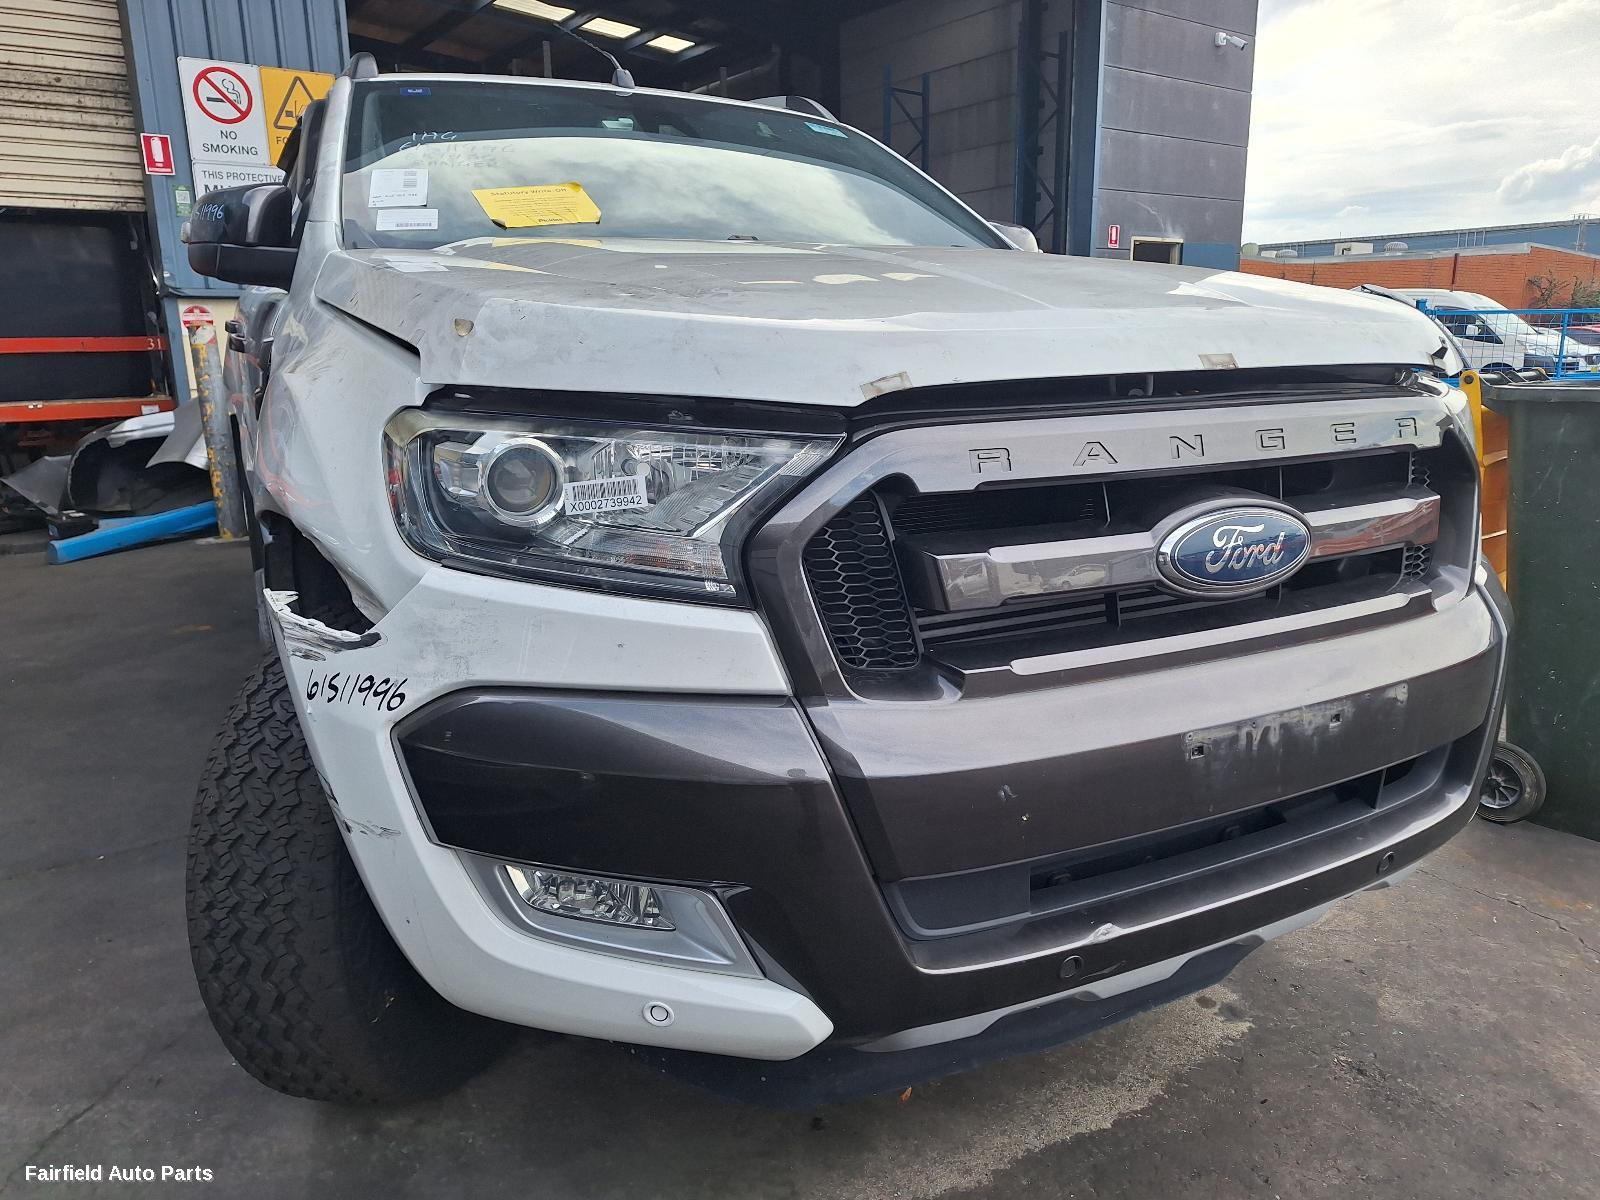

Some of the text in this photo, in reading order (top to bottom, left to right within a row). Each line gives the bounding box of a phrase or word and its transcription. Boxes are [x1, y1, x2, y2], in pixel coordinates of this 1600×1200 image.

[220, 130, 238, 140] NO
[202, 143, 258, 156] SMOKING
[202, 170, 283, 182] THIS PROTECTIVE
[968, 416, 1418, 475] RANGER
[570, 494, 643, 513] X0002739942
[1205, 523, 1286, 575] Ford
[306, 668, 409, 712] 61511996
